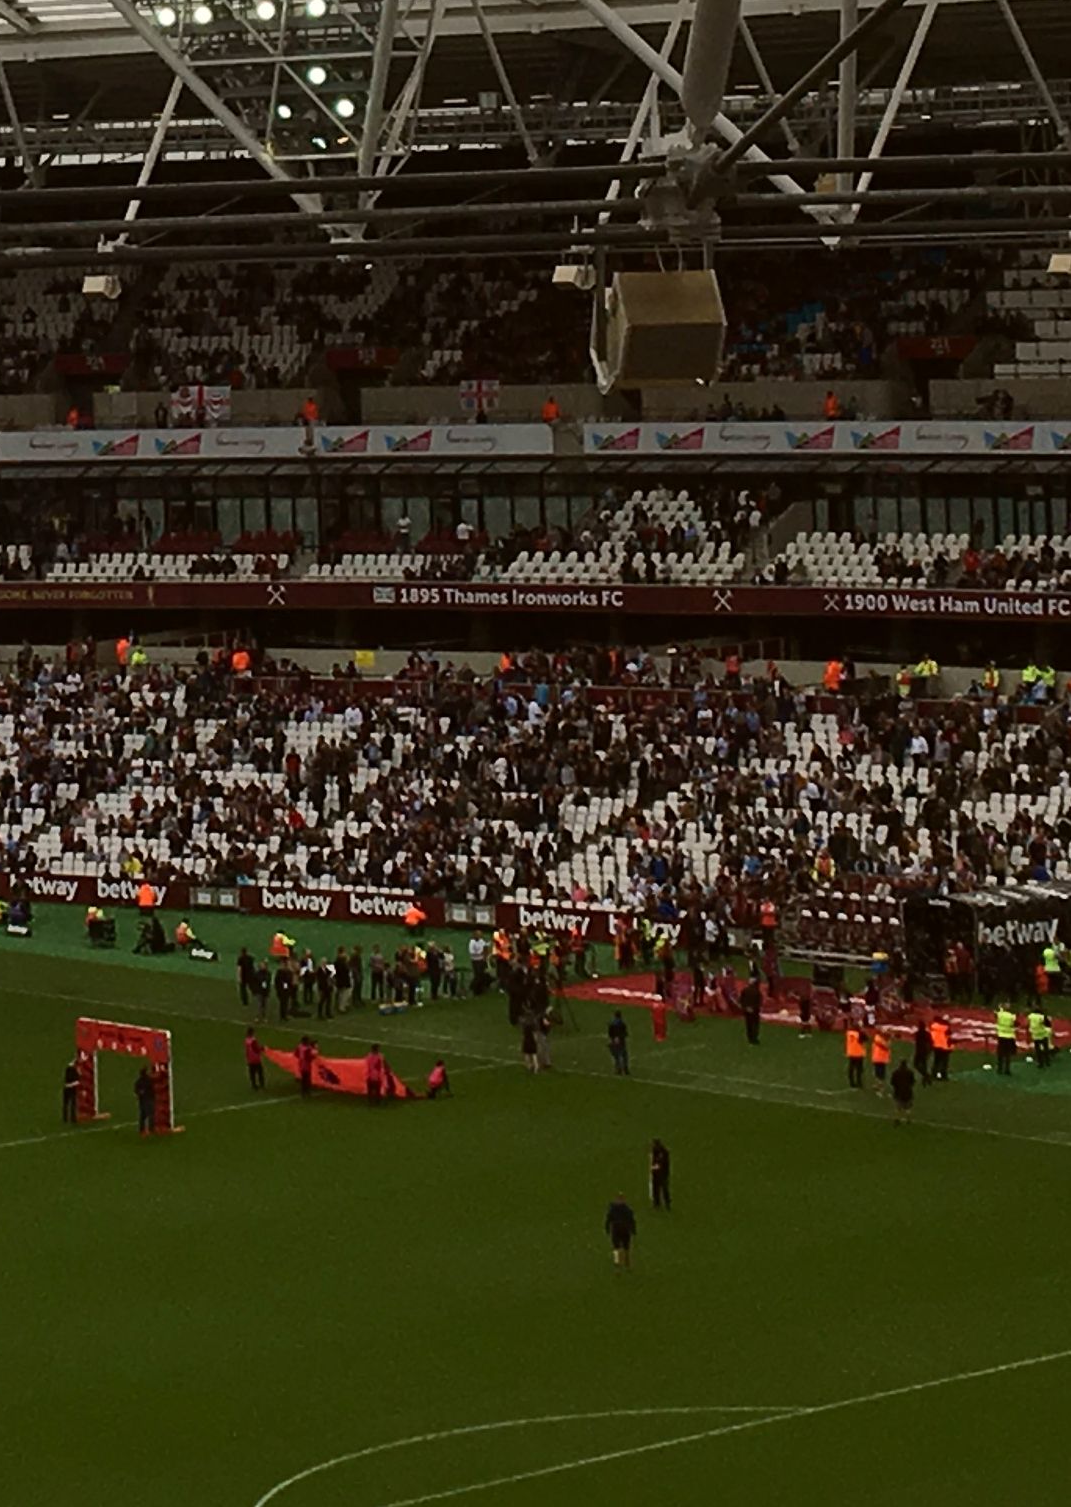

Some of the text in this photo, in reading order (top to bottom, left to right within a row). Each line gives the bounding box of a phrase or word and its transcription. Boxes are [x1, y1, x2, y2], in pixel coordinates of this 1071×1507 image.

[400, 587, 624, 607] 1895 Thames Ironworks FC
[844, 593, 1071, 617] 1900 West Ham United FC
[10, 874, 79, 901] tway
[97, 878, 167, 906] betwy
[262, 888, 332, 918] betway
